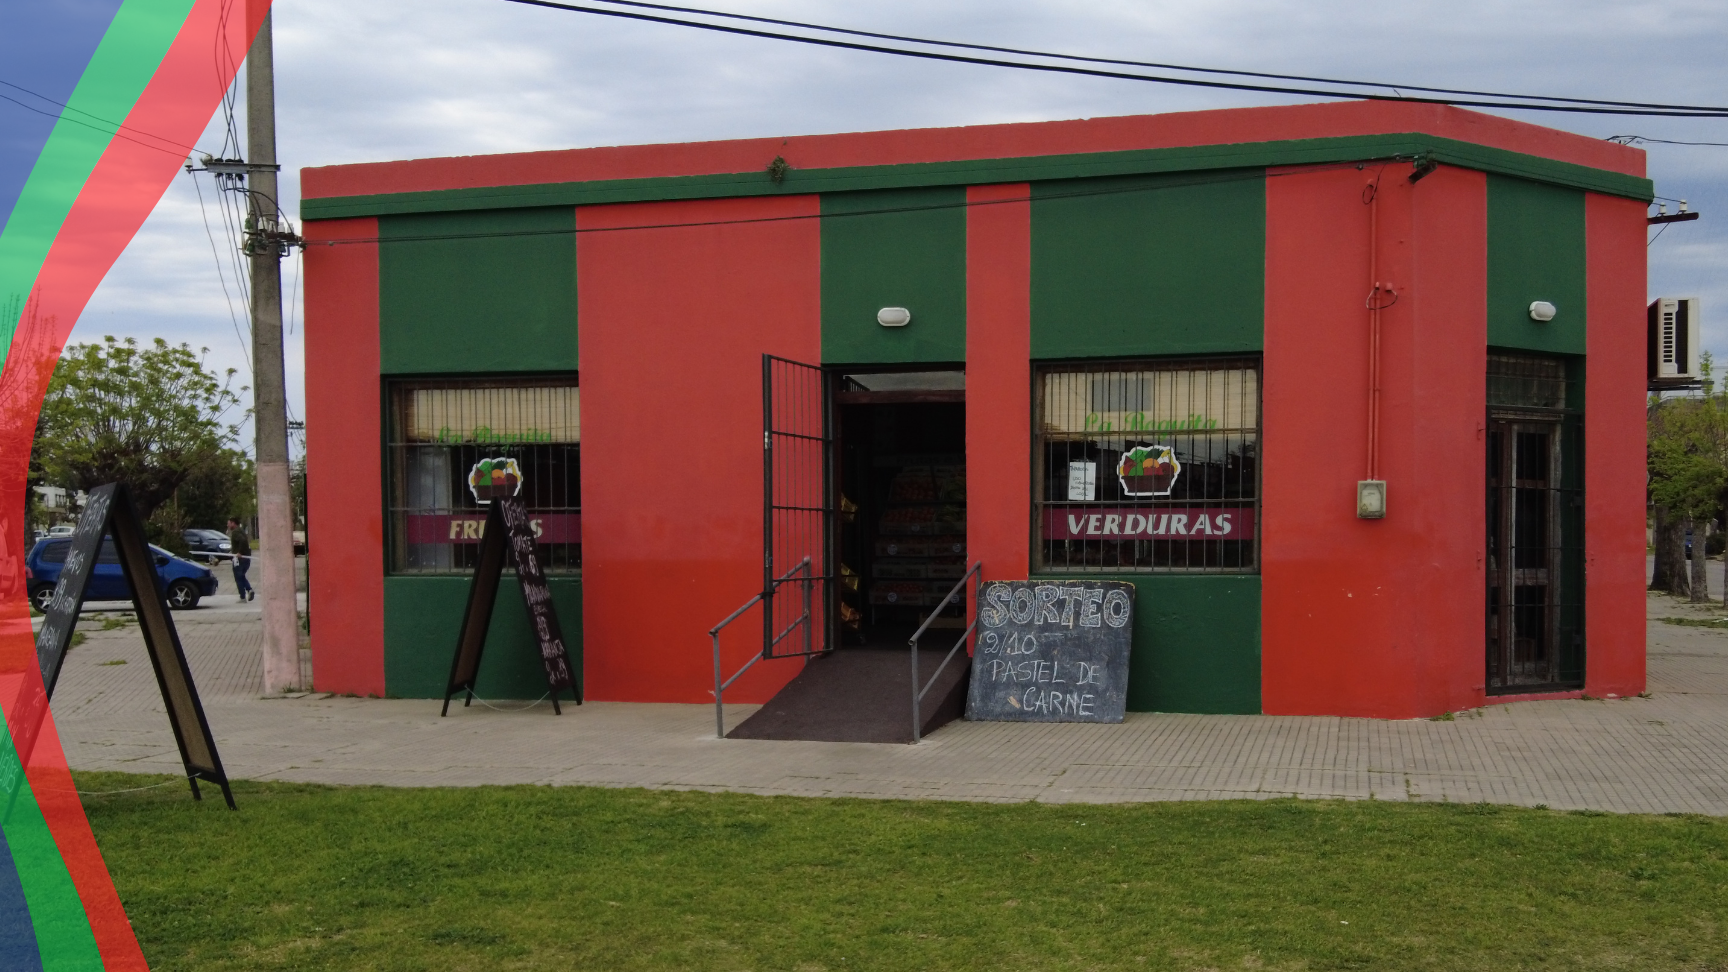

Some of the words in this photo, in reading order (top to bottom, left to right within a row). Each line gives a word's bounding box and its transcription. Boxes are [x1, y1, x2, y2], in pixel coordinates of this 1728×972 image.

[449, 519, 543, 540] FRS
[1067, 513, 1232, 536] VERDURAS
[981, 583, 1130, 628] SORTEO
[984, 631, 1037, 656] 2/10
[987, 659, 1066, 683] PASTEL
[1076, 661, 1101, 685] DE
[1022, 686, 1095, 716] CARNE
